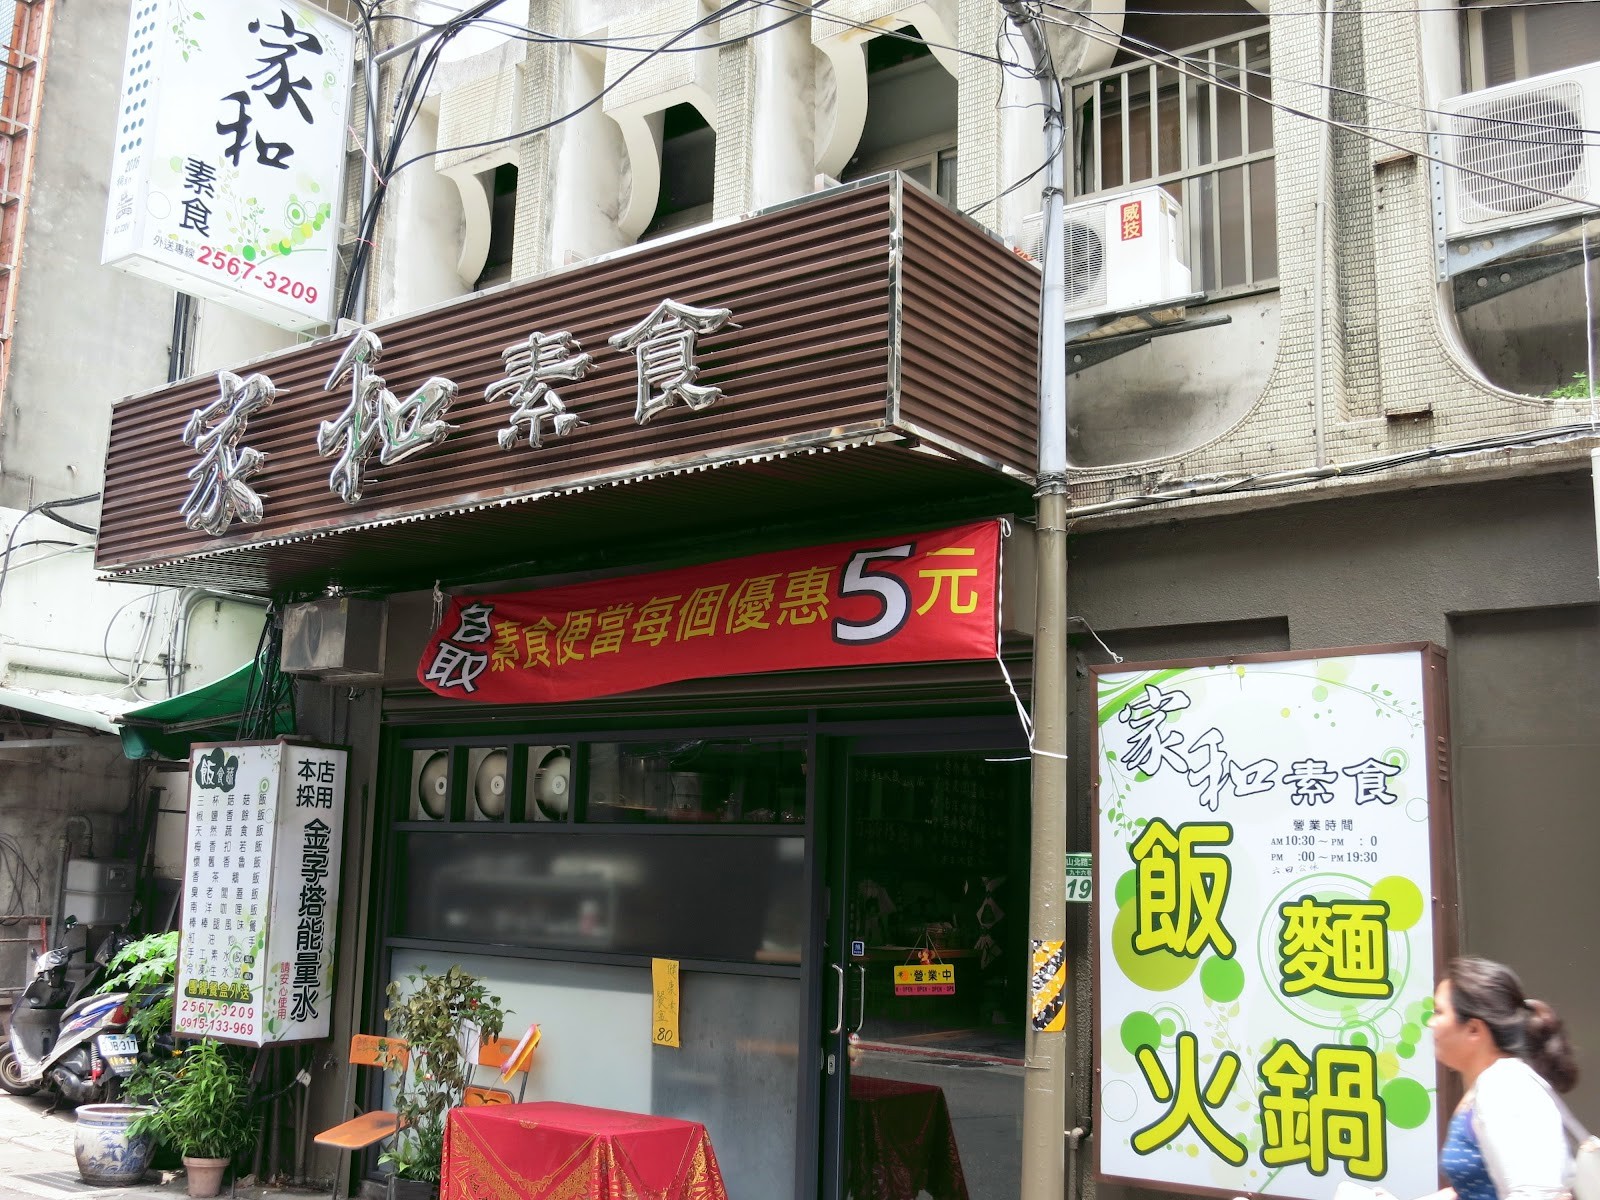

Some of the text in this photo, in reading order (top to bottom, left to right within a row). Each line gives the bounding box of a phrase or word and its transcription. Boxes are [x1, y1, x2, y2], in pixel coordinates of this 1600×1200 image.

[215, 9, 323, 169] 家和
[179, 157, 216, 237] 素食
[1122, 203, 1140, 240] 威技
[153, 236, 195, 261] 外送專線
[197, 245, 318, 304] 2567-3209
[179, 297, 734, 537] 家和素食
[424, 602, 494, 693] 自取
[1118, 684, 1401, 812] 家和素食
[298, 758, 335, 784] 本店
[296, 784, 333, 810] 採用
[1270, 838, 1283, 846] AM
[1285, 835, 1315, 846] 10:30
[1331, 838, 1344, 846] PM
[1293, 819, 1353, 831] 營業時間
[1271, 853, 1284, 861] PM
[1331, 854, 1344, 862] PM
[1346, 851, 1378, 862] 19:30
[1067, 878, 1092, 899] 19
[1129, 816, 1236, 960] 飯
[290, 817, 330, 1023] 金字塔能量水
[1278, 894, 1394, 1000] 麵
[277, 961, 290, 1020] 請安心使用
[914, 968, 951, 981] 營業中
[180, 1017, 253, 1036] 0915-133-969
[182, 1000, 254, 1019] 2567-3209
[657, 1027, 673, 1042] 80
[1130, 1031, 1388, 1182] 火鍋
